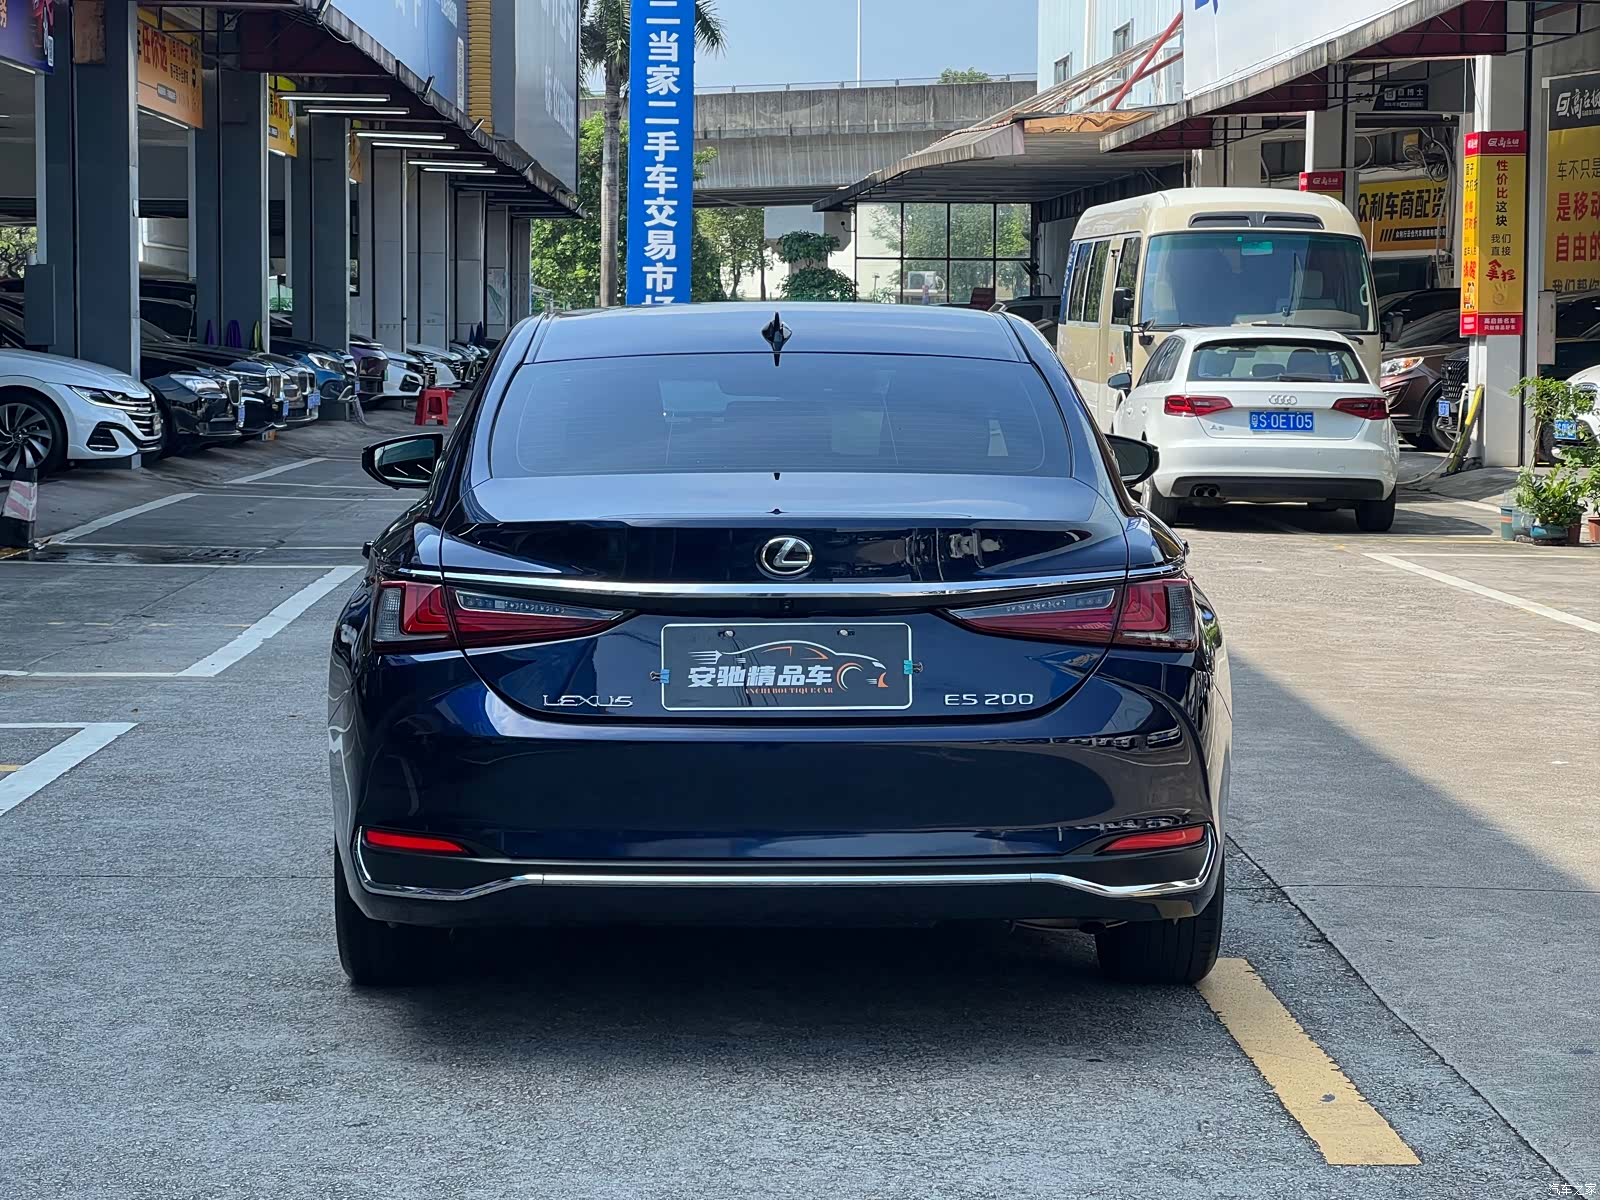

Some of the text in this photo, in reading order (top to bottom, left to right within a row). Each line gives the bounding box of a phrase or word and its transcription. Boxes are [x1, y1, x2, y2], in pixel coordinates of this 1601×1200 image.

[1496, 159, 1508, 227] 性价比这块
[1491, 233, 1511, 244] 我们
[1491, 246, 1511, 256] 直接
[687, 665, 833, 688] 安驰精品车
[542, 694, 633, 707] LEXUS
[944, 693, 1034, 705] ES 200
